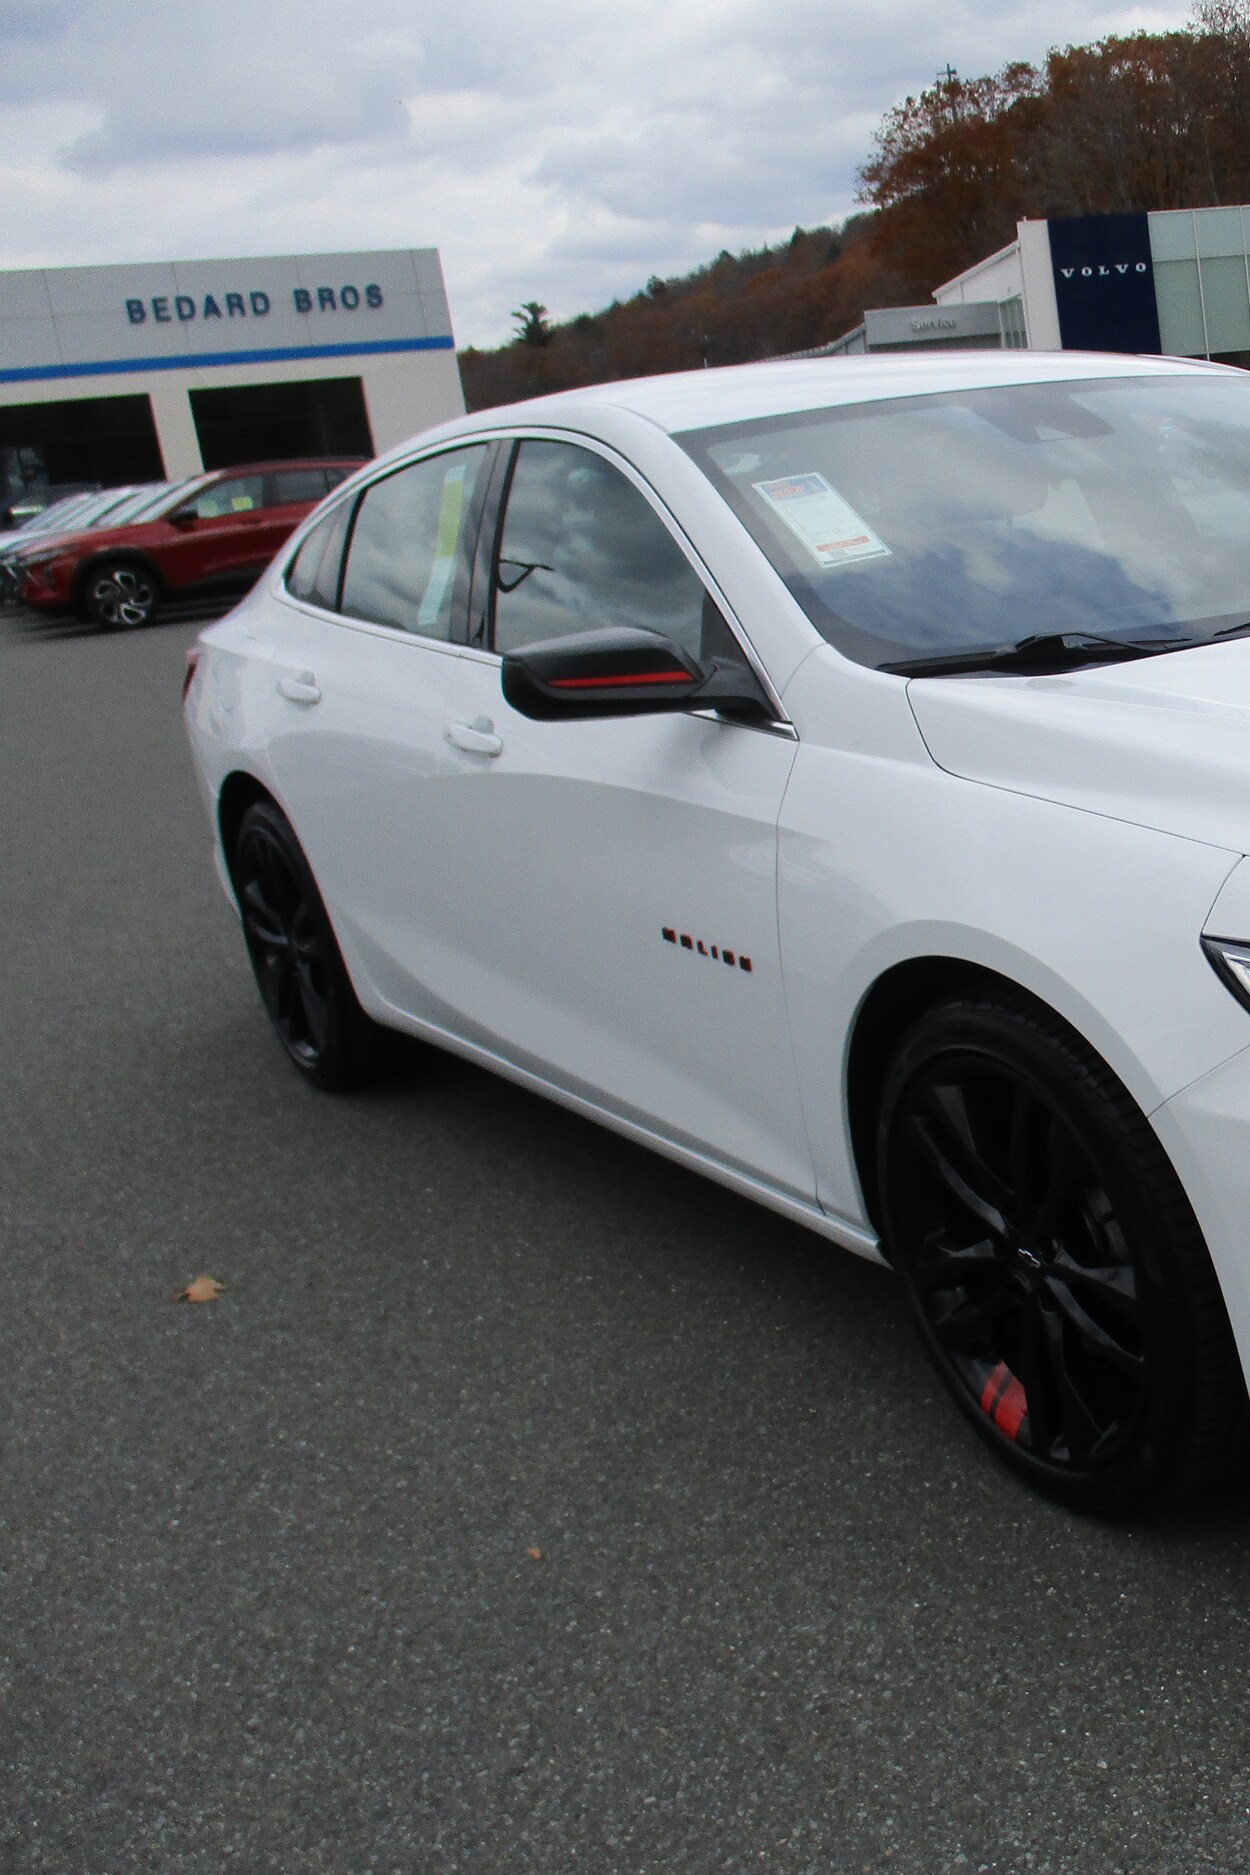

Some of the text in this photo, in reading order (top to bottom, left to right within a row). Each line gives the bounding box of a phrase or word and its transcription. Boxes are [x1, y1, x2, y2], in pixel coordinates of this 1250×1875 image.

[1060, 262, 1147, 278] VOLVO
[125, 283, 384, 325] BEDARD BROS
